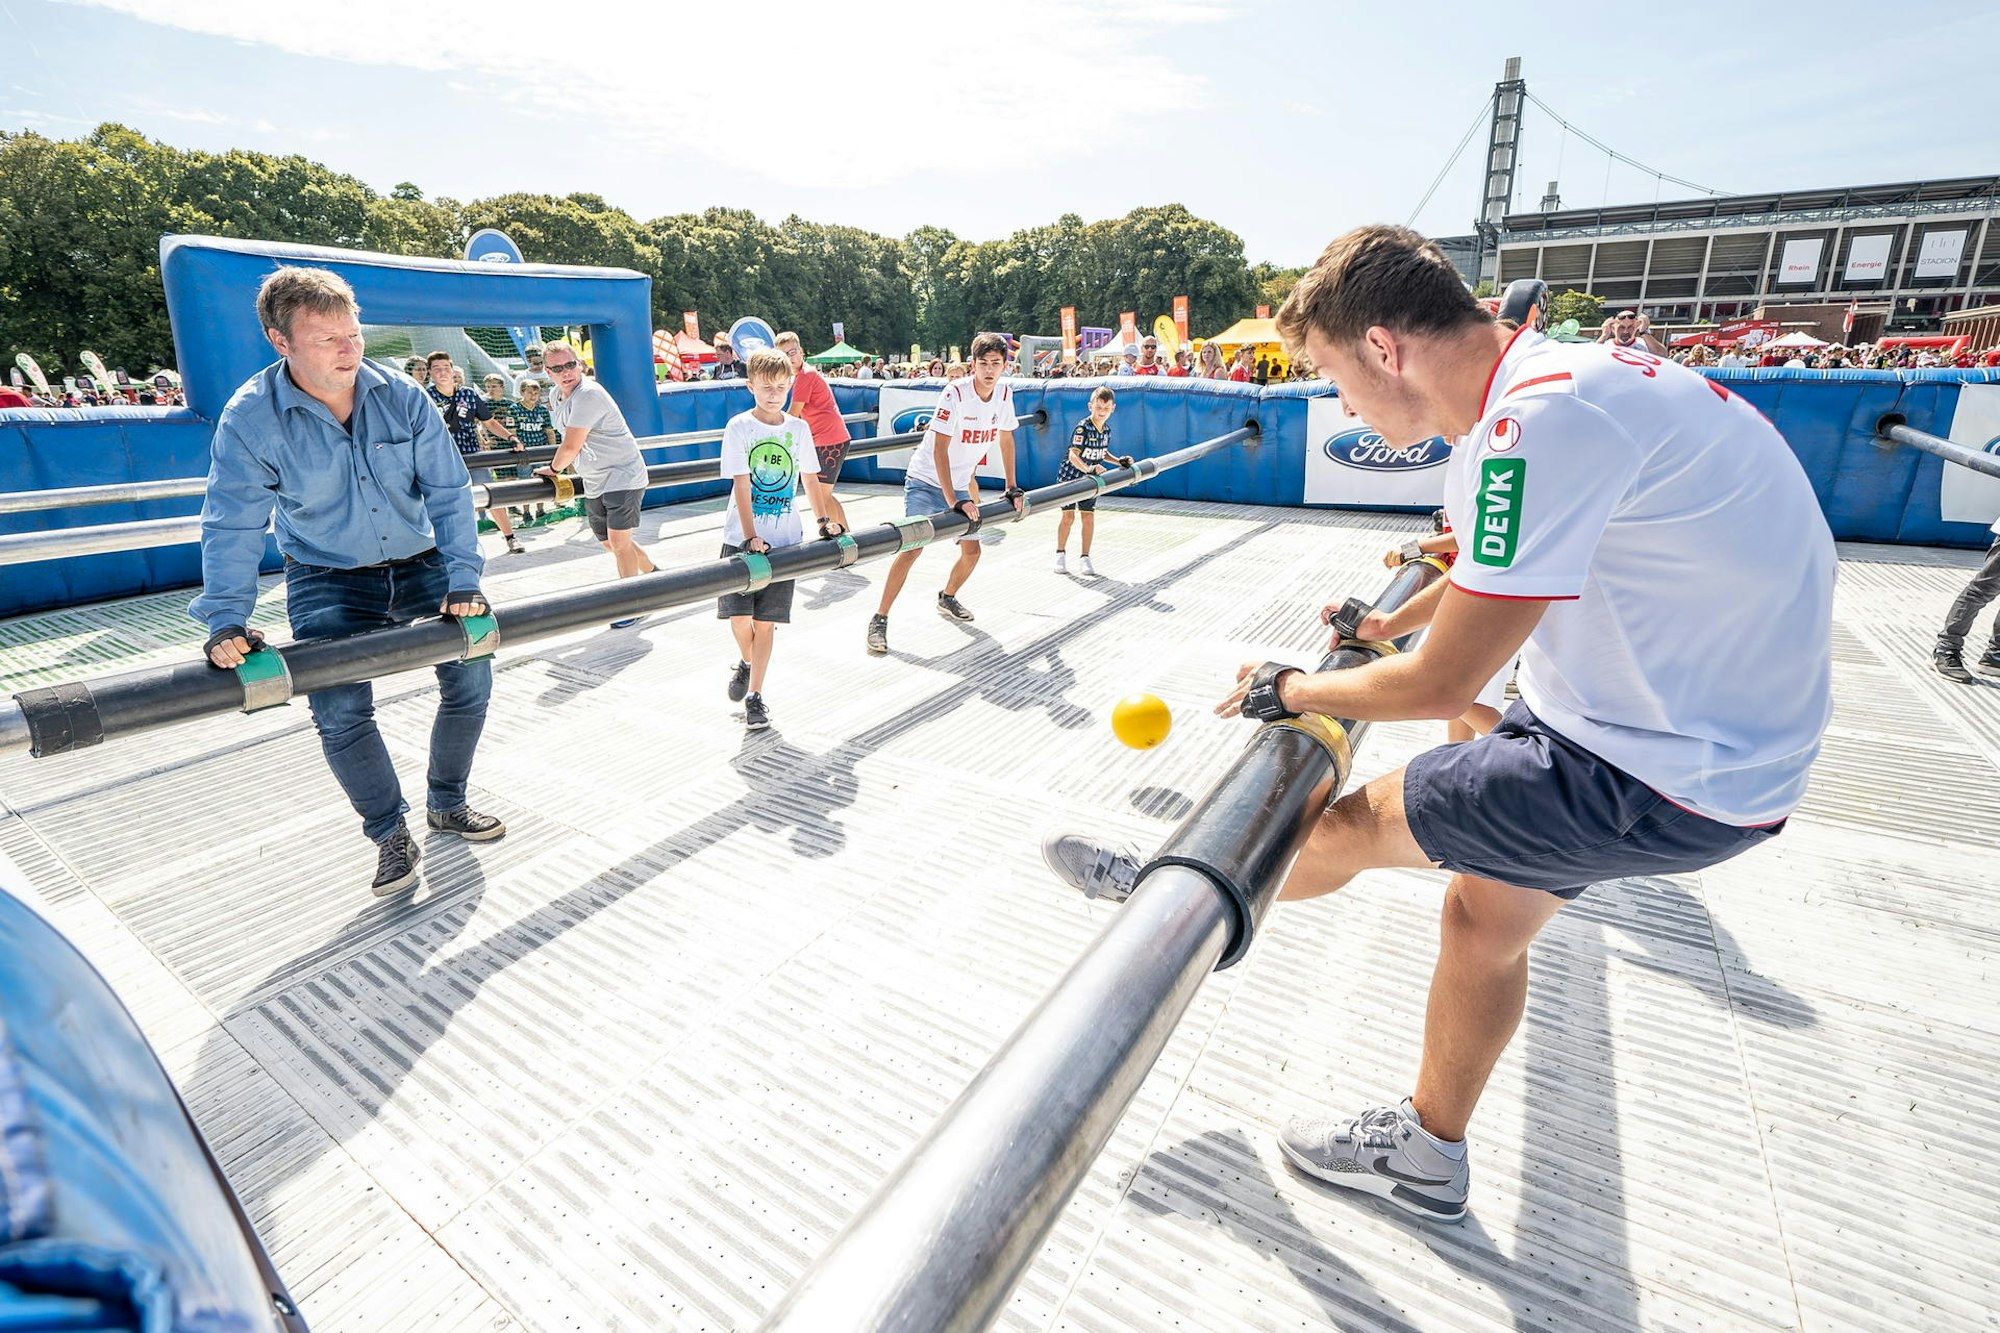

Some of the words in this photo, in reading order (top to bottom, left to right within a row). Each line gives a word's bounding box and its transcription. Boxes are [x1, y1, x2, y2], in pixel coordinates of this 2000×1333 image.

[1851, 260, 1882, 269] Energie
[1920, 257, 1958, 265] STADION
[961, 428, 998, 444] REWE
[1349, 432, 1434, 463] Ford
[770, 454, 782, 466] BE
[751, 494, 791, 508] ESOME
[1480, 469, 1515, 558] DEVK
